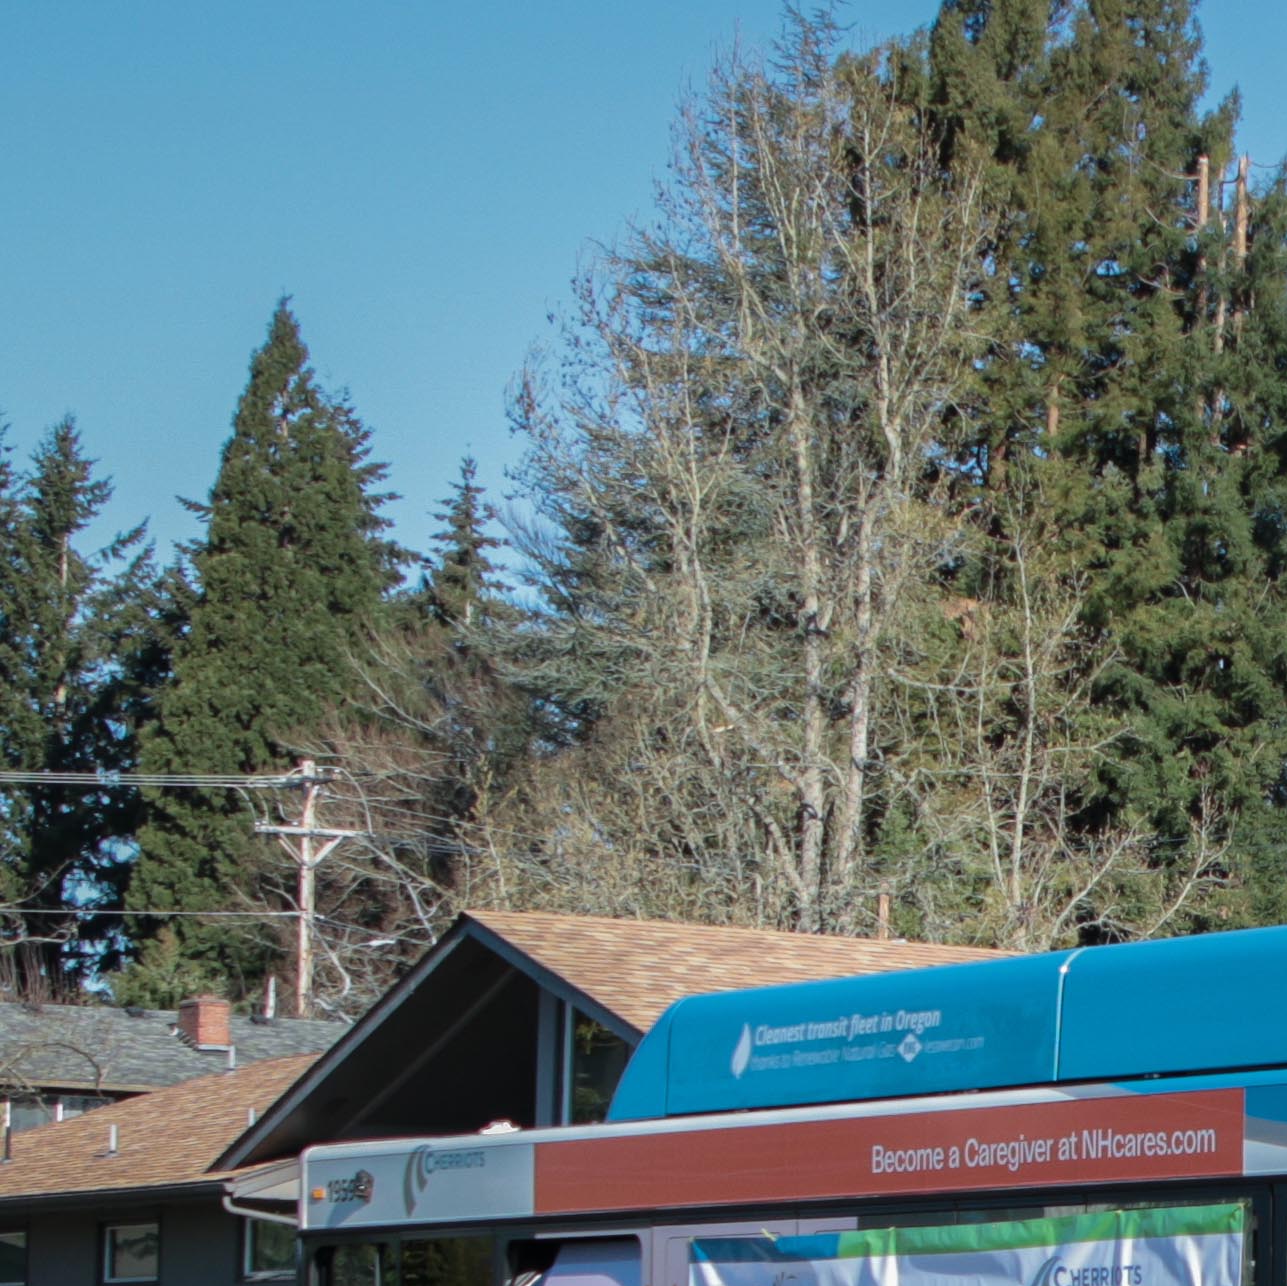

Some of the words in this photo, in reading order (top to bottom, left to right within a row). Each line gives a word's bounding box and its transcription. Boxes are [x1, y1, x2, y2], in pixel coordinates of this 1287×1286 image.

[755, 1023, 804, 1046] Cleanest
[807, 1017, 848, 1038] transit
[848, 1014, 878, 1042] fleet
[881, 1011, 893, 1032] in
[896, 1010, 941, 1034] Oregon
[424, 1151, 486, 1175] CHERRIOTS
[872, 1145, 944, 1173] Become
[949, 1145, 960, 1169] a
[964, 1134, 1053, 1171] Caregiver
[1058, 1131, 1077, 1161] at
[1081, 1128, 1216, 1160] NHcares.com
